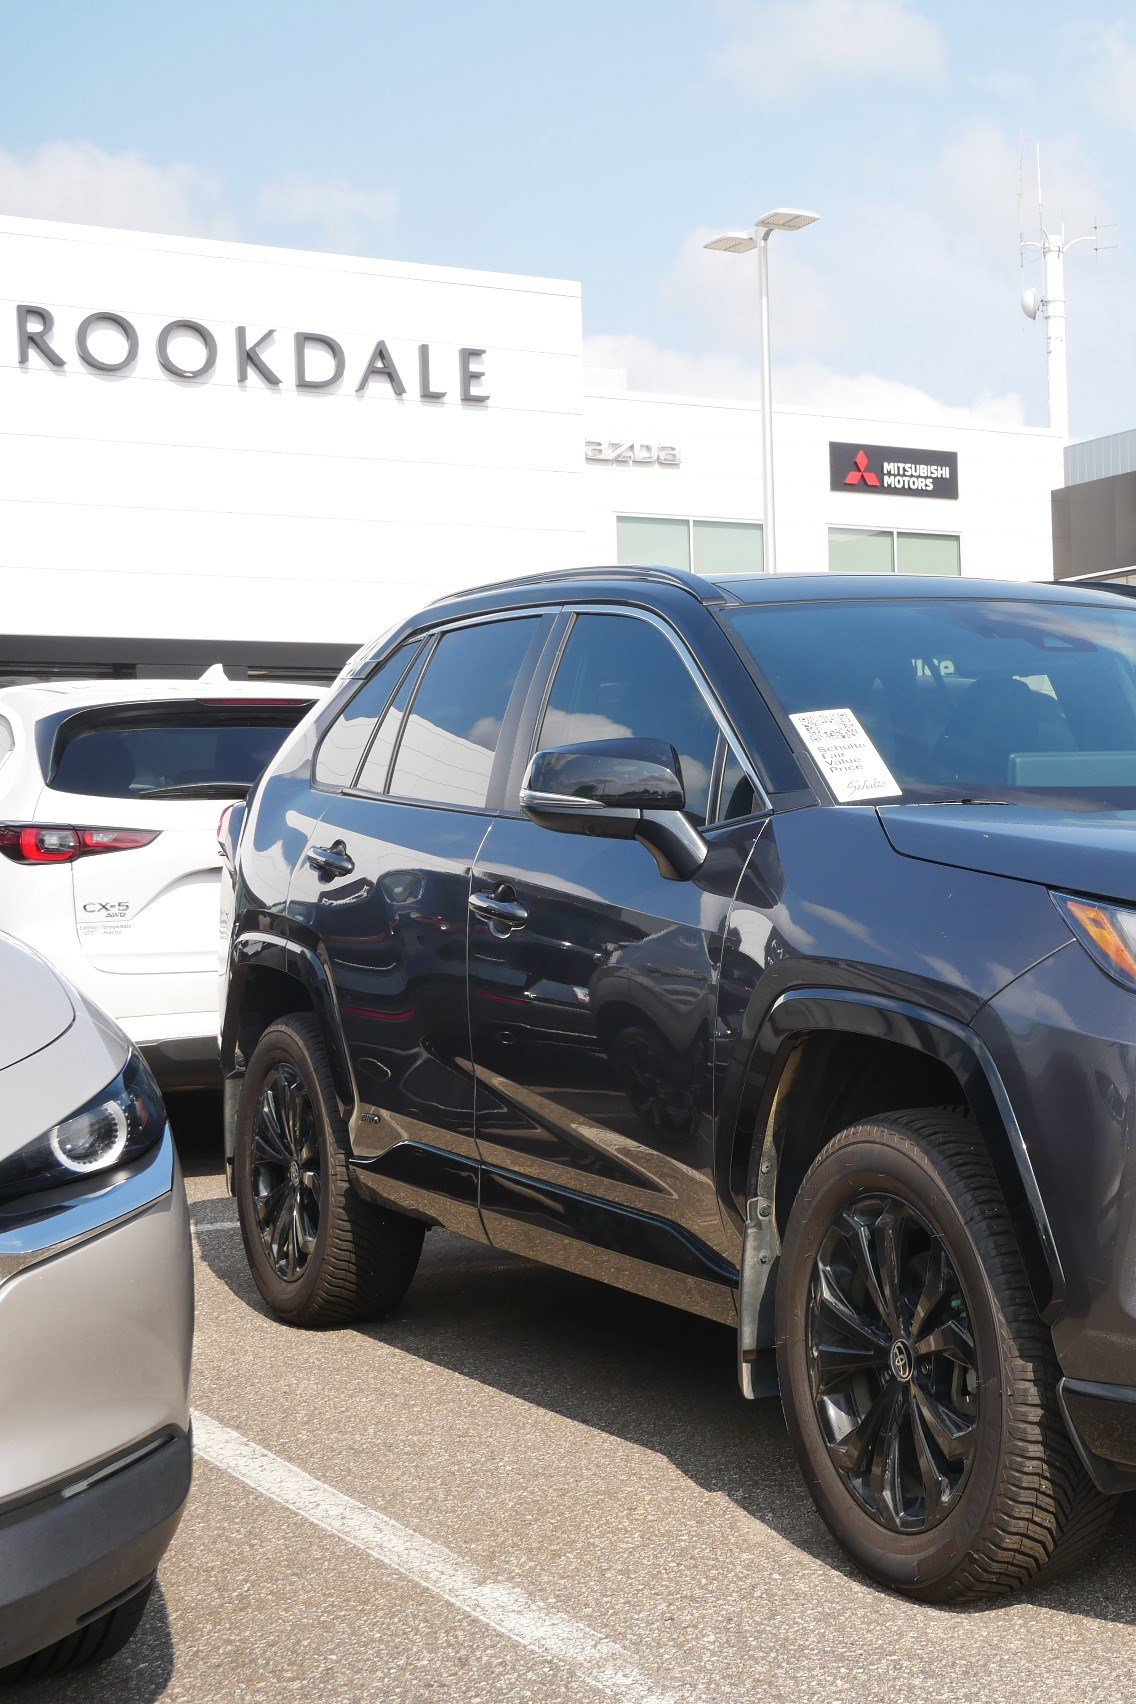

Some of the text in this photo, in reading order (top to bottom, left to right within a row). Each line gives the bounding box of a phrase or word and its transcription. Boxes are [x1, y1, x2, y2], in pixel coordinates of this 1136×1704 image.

[16, 303, 491, 402] ROOKDALE
[883, 461, 950, 480] MITSUBISHI
[883, 475, 934, 491] MOTORS
[83, 901, 130, 913] CX-5
